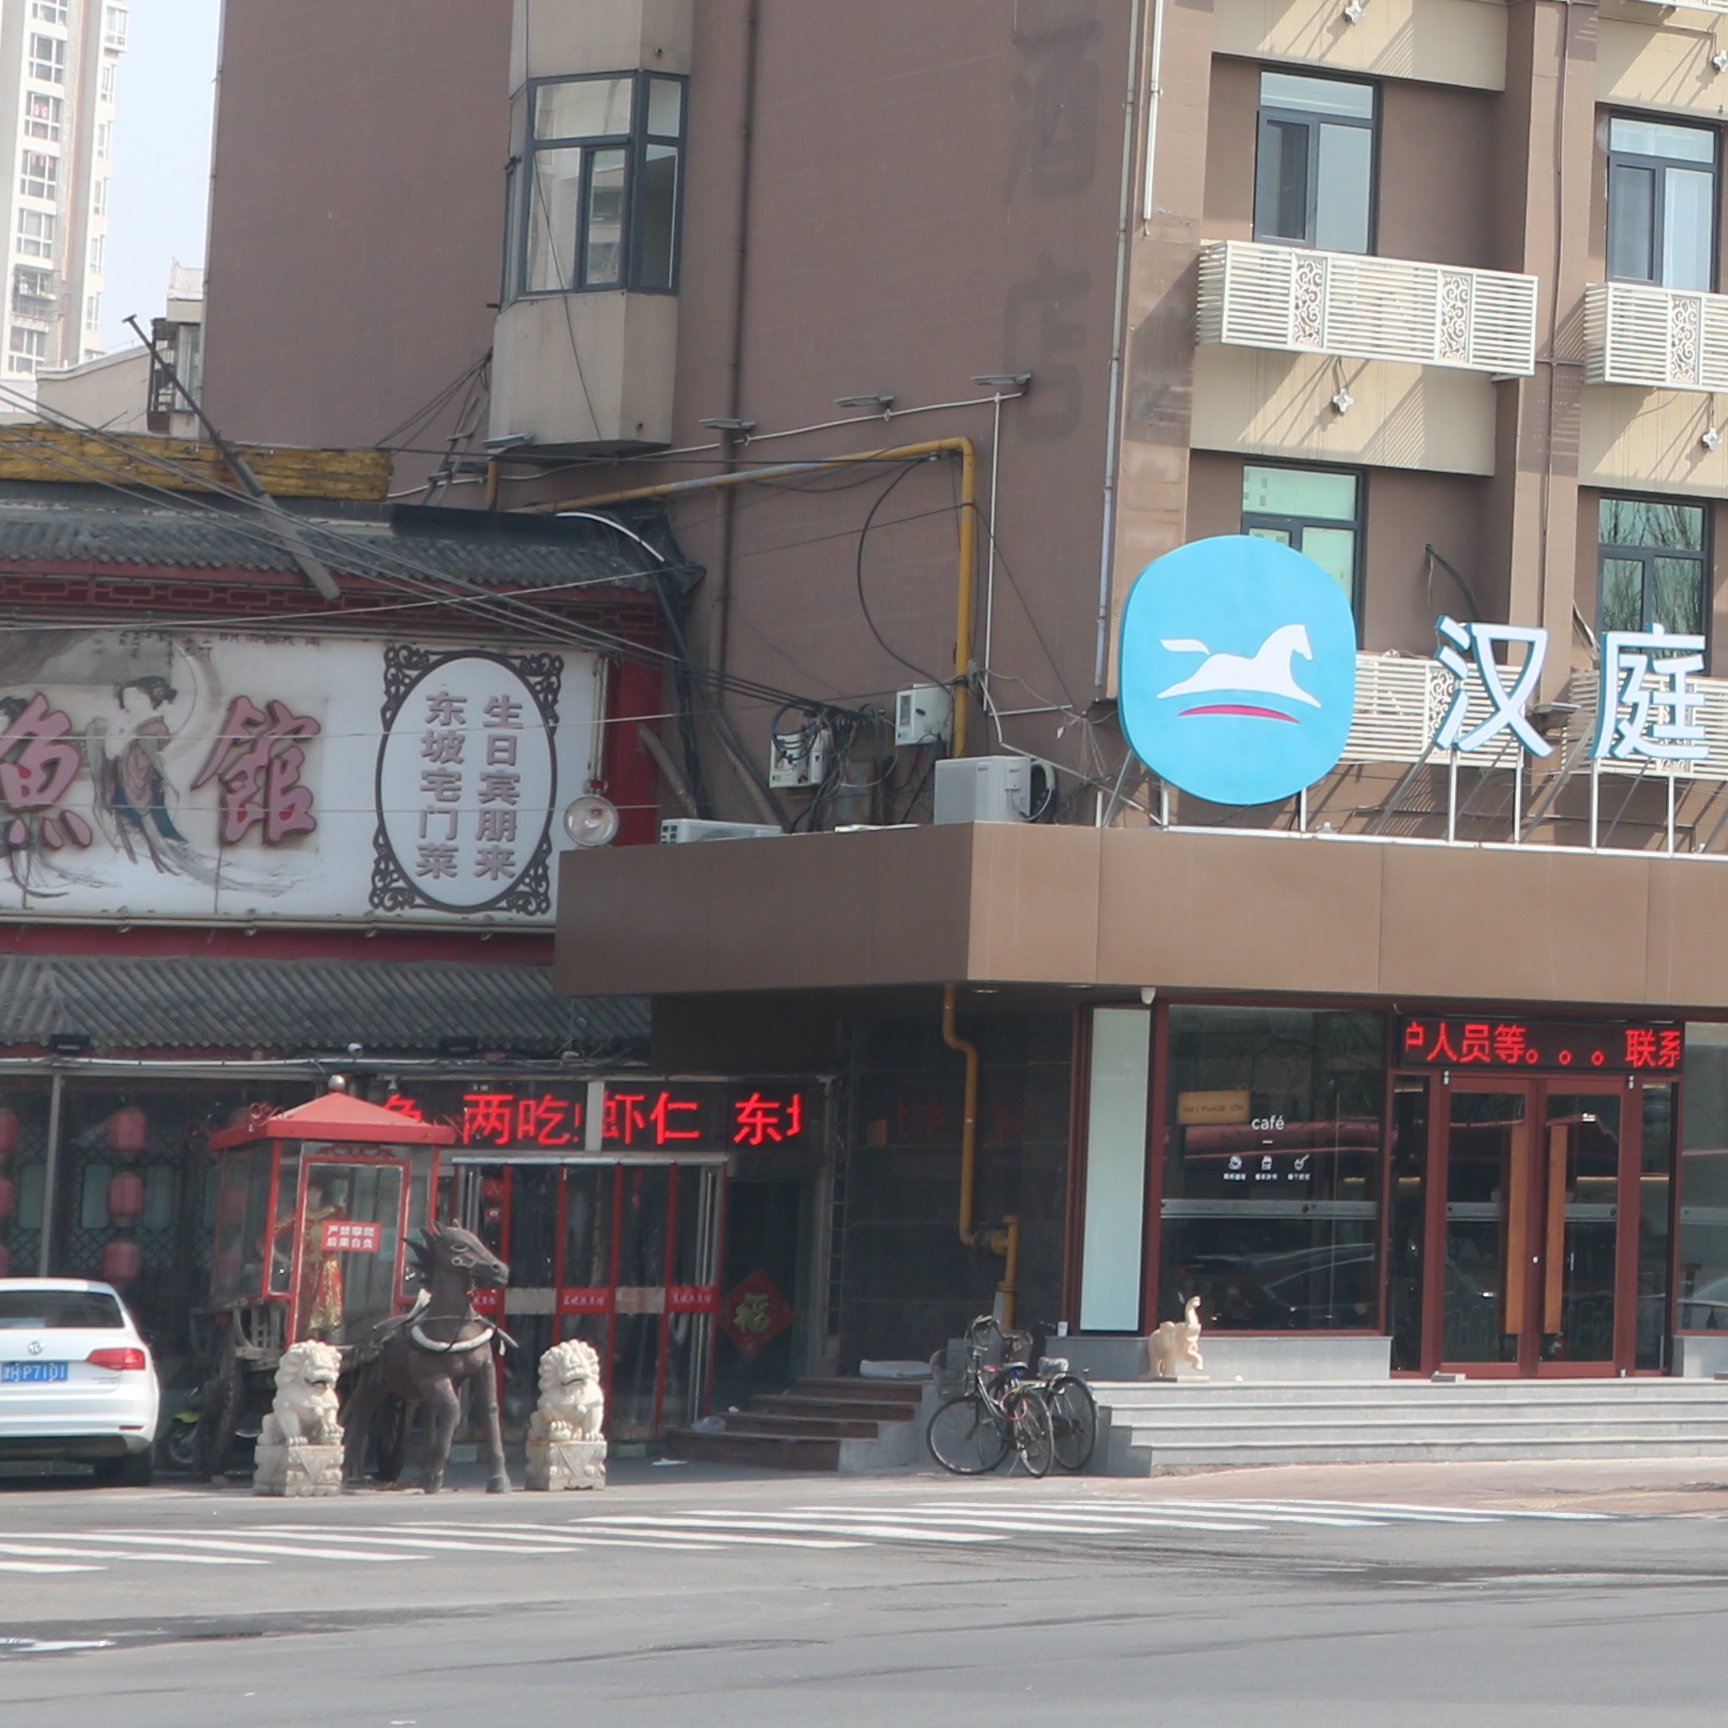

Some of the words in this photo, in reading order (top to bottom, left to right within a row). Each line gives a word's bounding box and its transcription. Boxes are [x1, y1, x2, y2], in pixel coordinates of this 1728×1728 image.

[416, 691, 468, 879] 东坡宅门菜
[475, 694, 524, 881] 生日宾朋来
[1252, 1115, 1284, 1130] café
